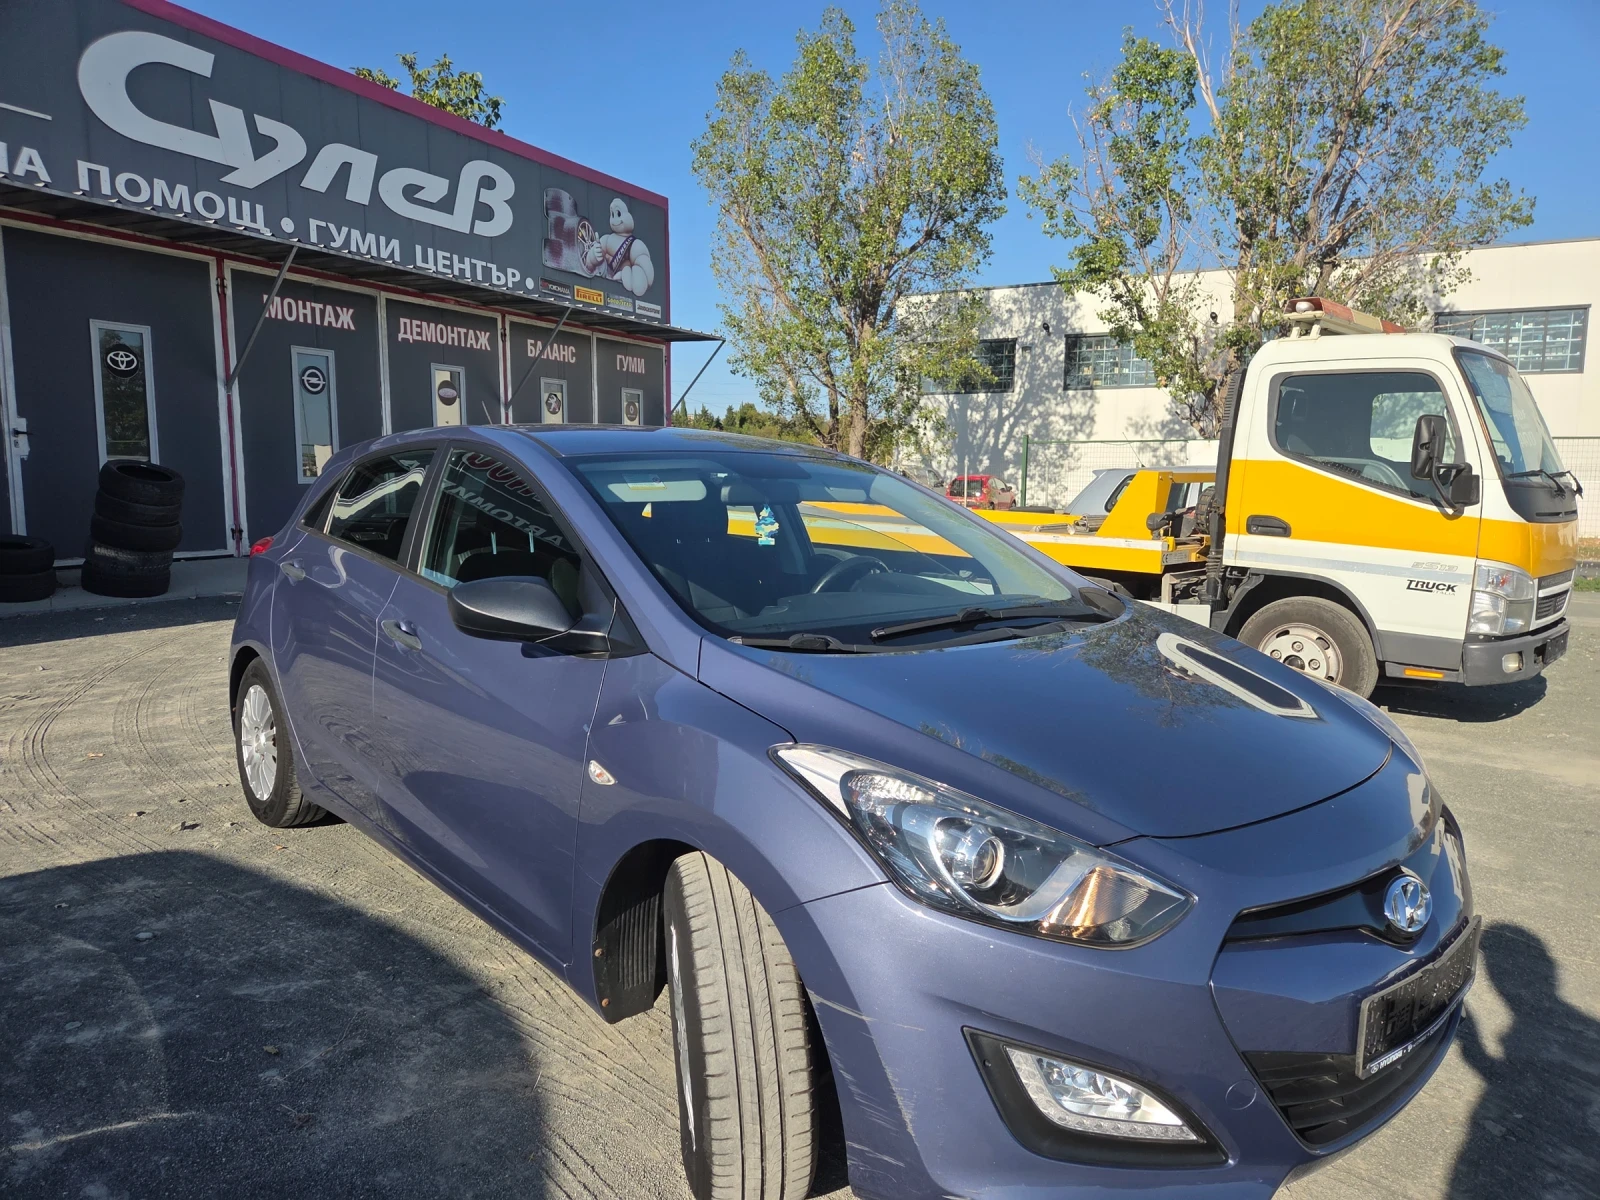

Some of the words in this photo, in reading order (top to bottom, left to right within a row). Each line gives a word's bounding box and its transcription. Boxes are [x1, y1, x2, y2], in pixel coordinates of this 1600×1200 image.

[77, 160, 271, 235] ПОМОЩ
[308, 218, 400, 262] ГУМИ
[415, 244, 520, 288] ЦЕНТЪР
[576, 288, 602, 304] PIRELLI
[263, 294, 356, 331] МОНТАЖ
[398, 317, 491, 351] ДЕМОНТАЖ
[527, 338, 576, 364] БАЛАНС
[616, 354, 645, 374] ГУМИ
[1406, 579, 1458, 593] TRUCK
